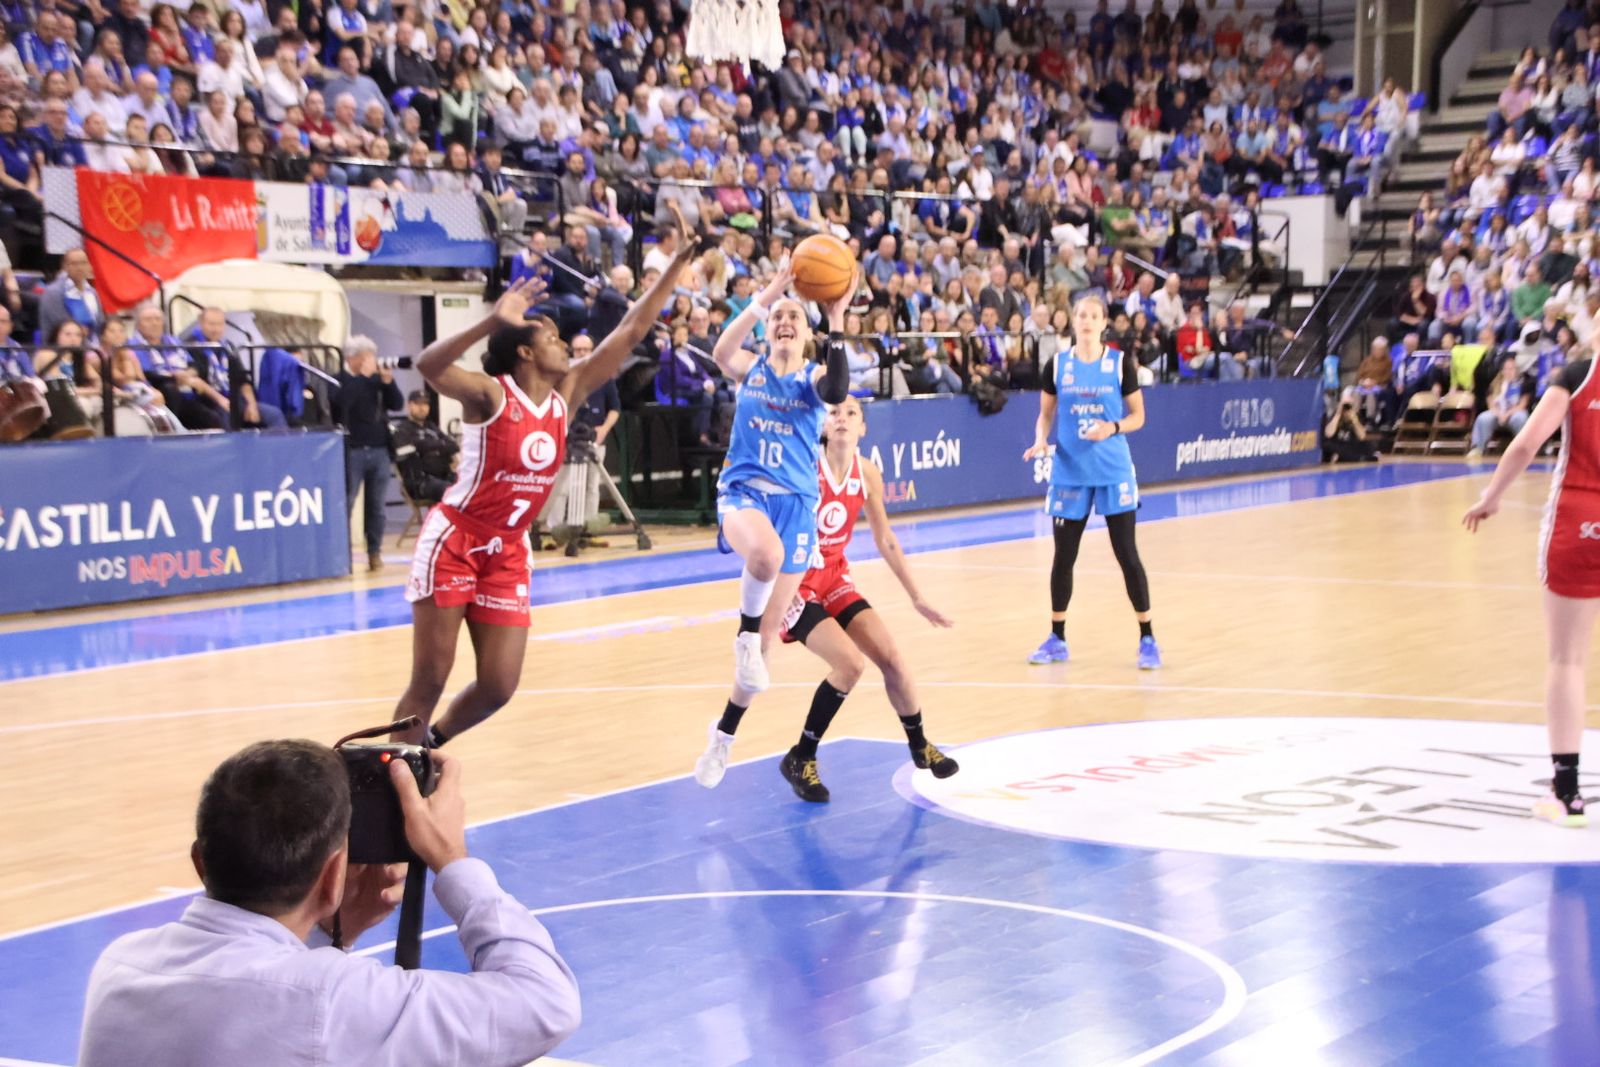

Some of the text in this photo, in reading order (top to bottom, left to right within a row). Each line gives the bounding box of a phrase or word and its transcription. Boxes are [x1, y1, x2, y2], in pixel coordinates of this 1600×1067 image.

[758, 438, 783, 468] 10
[892, 442, 906, 479] Y
[911, 429, 961, 471] LEÓN
[192, 494, 220, 543] Y
[234, 474, 324, 532] LEÓN
[507, 498, 531, 527] 7
[78, 545, 243, 588] NOS IMPULSA
